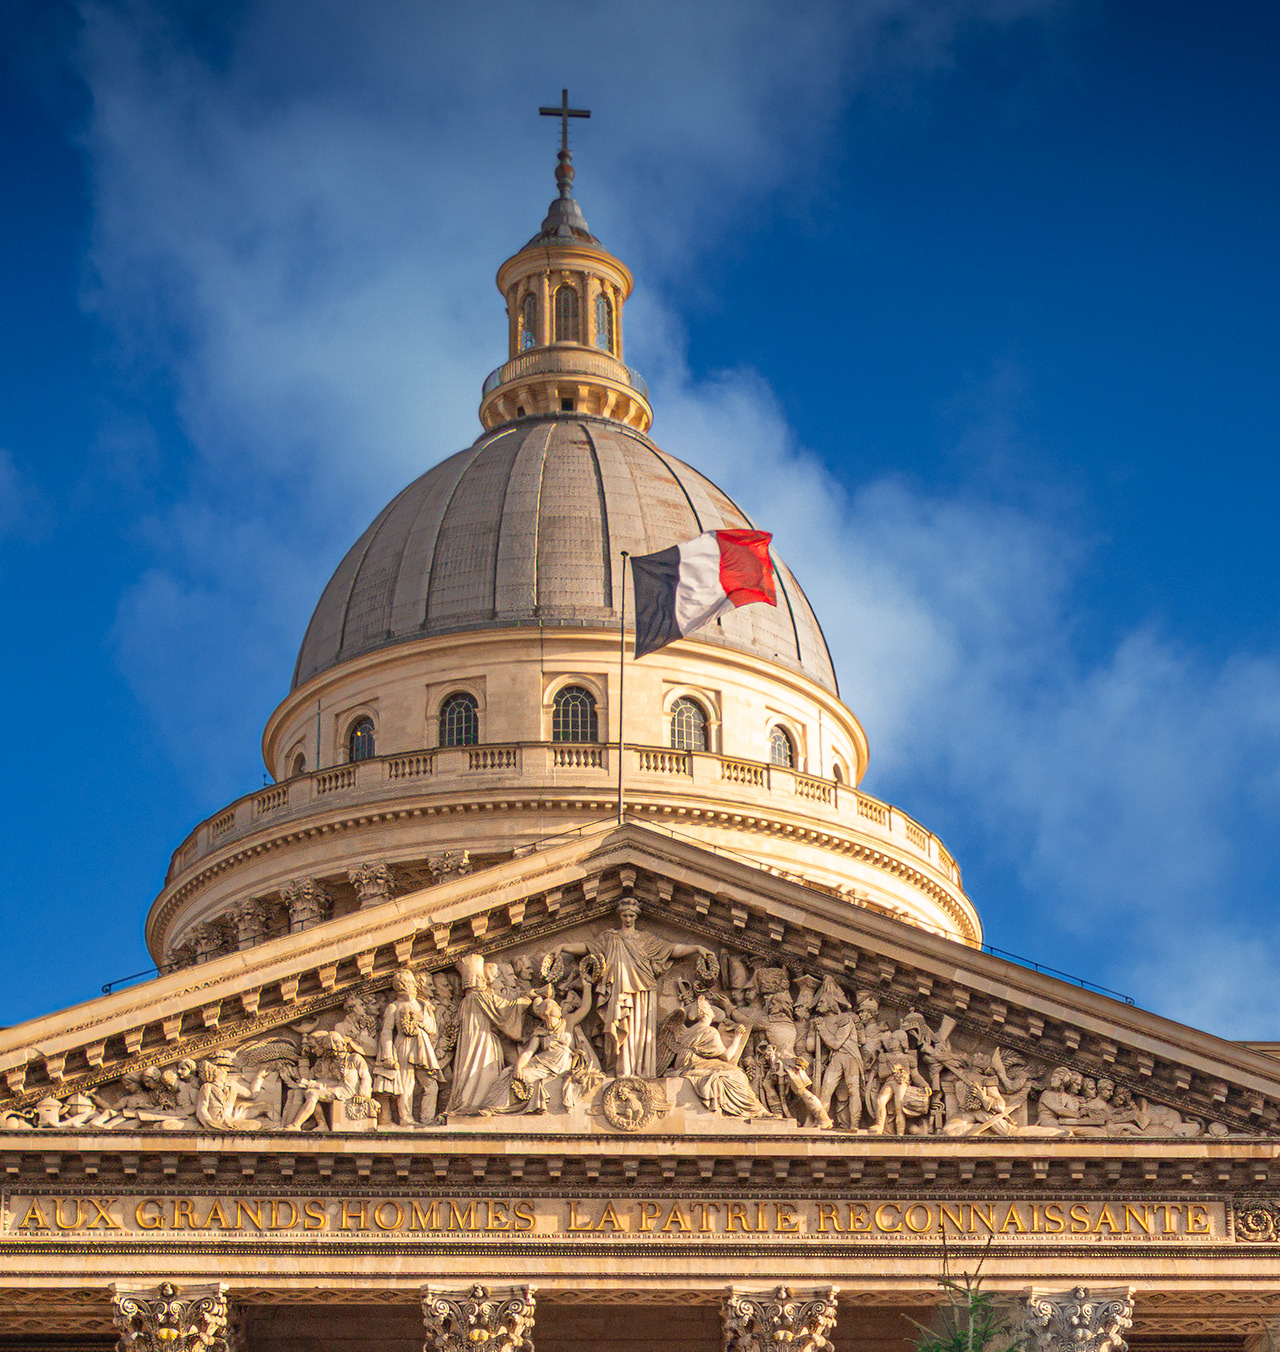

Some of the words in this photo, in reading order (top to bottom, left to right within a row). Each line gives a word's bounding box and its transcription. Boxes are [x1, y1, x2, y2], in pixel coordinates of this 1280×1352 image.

[19, 1197, 121, 1230] AUX
[135, 1199, 327, 1230] GRANDS
[338, 1200, 537, 1231] HOMMES
[567, 1200, 625, 1232] LA
[637, 1200, 800, 1233] PATRIE
[816, 1201, 1211, 1235] RECONNAISSANTE
